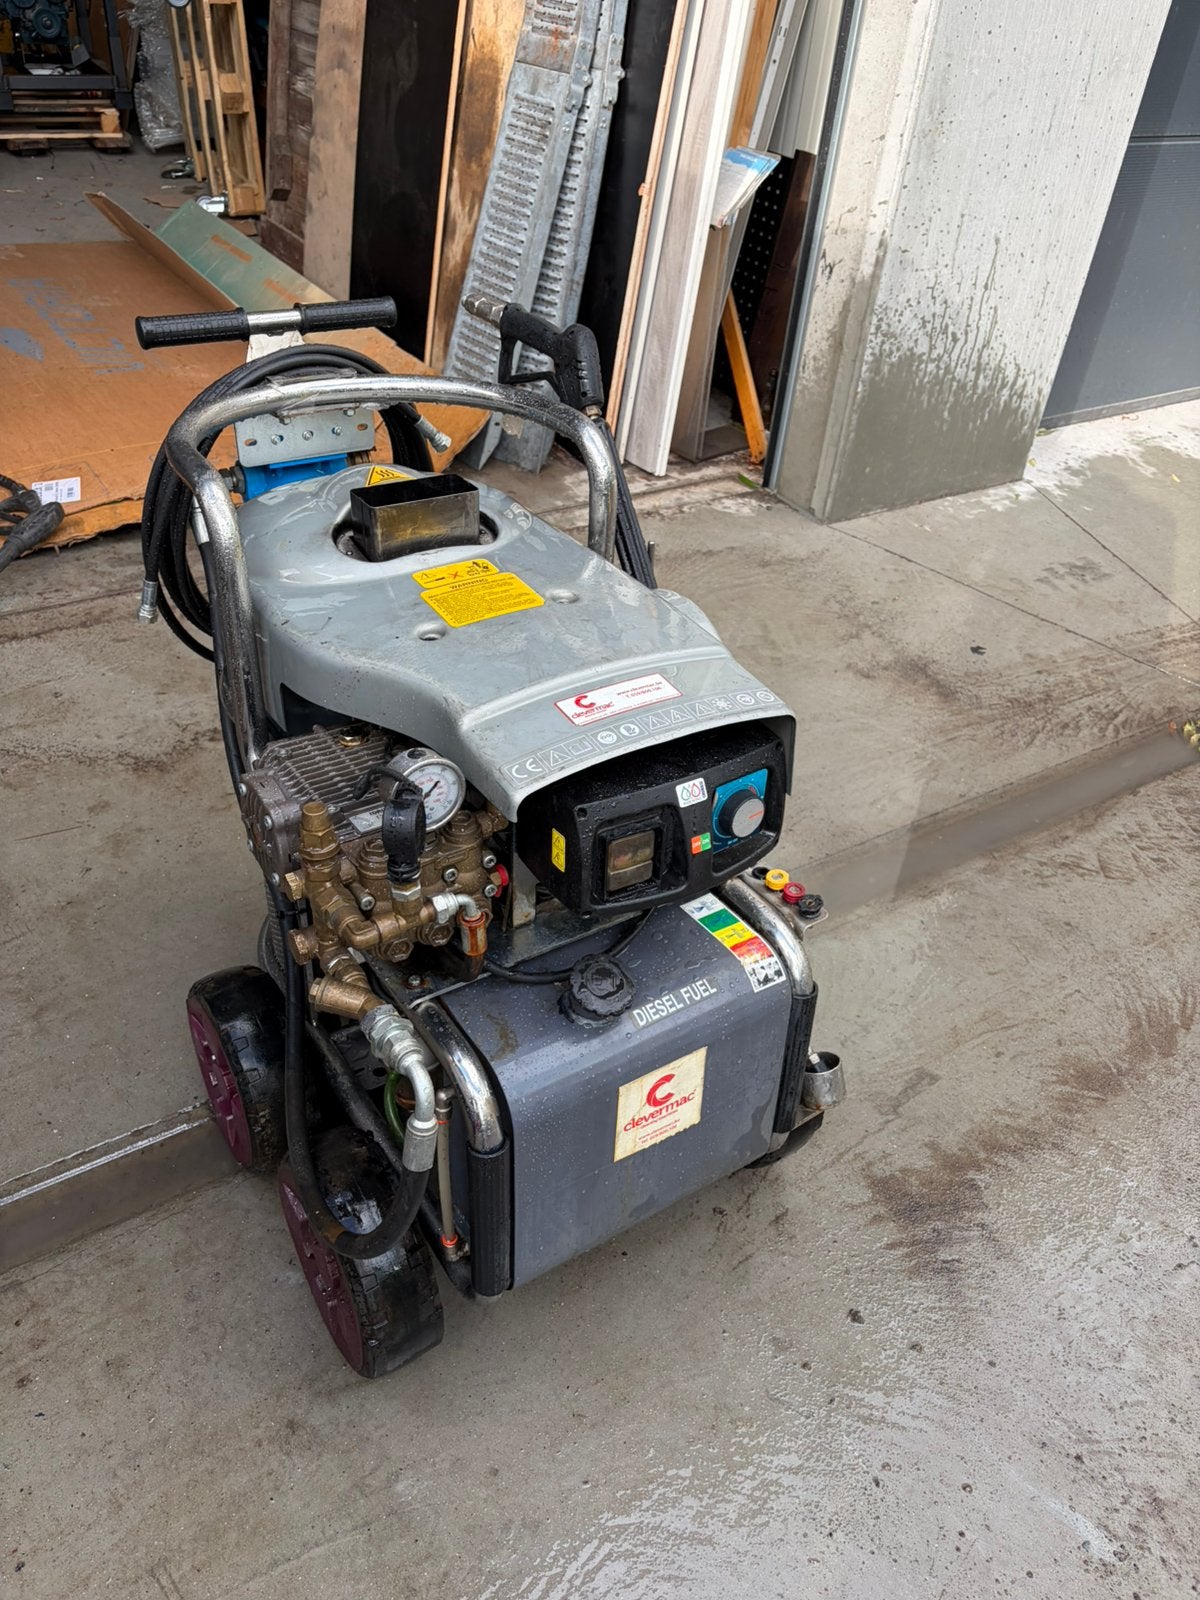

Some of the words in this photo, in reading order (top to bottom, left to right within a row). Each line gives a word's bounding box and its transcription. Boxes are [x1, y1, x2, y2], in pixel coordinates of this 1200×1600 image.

[571, 701, 614, 719] clevermac
[633, 994, 684, 1026] DIESEL
[680, 979, 717, 1005] FUEL
[623, 1091, 696, 1132] clevermac
